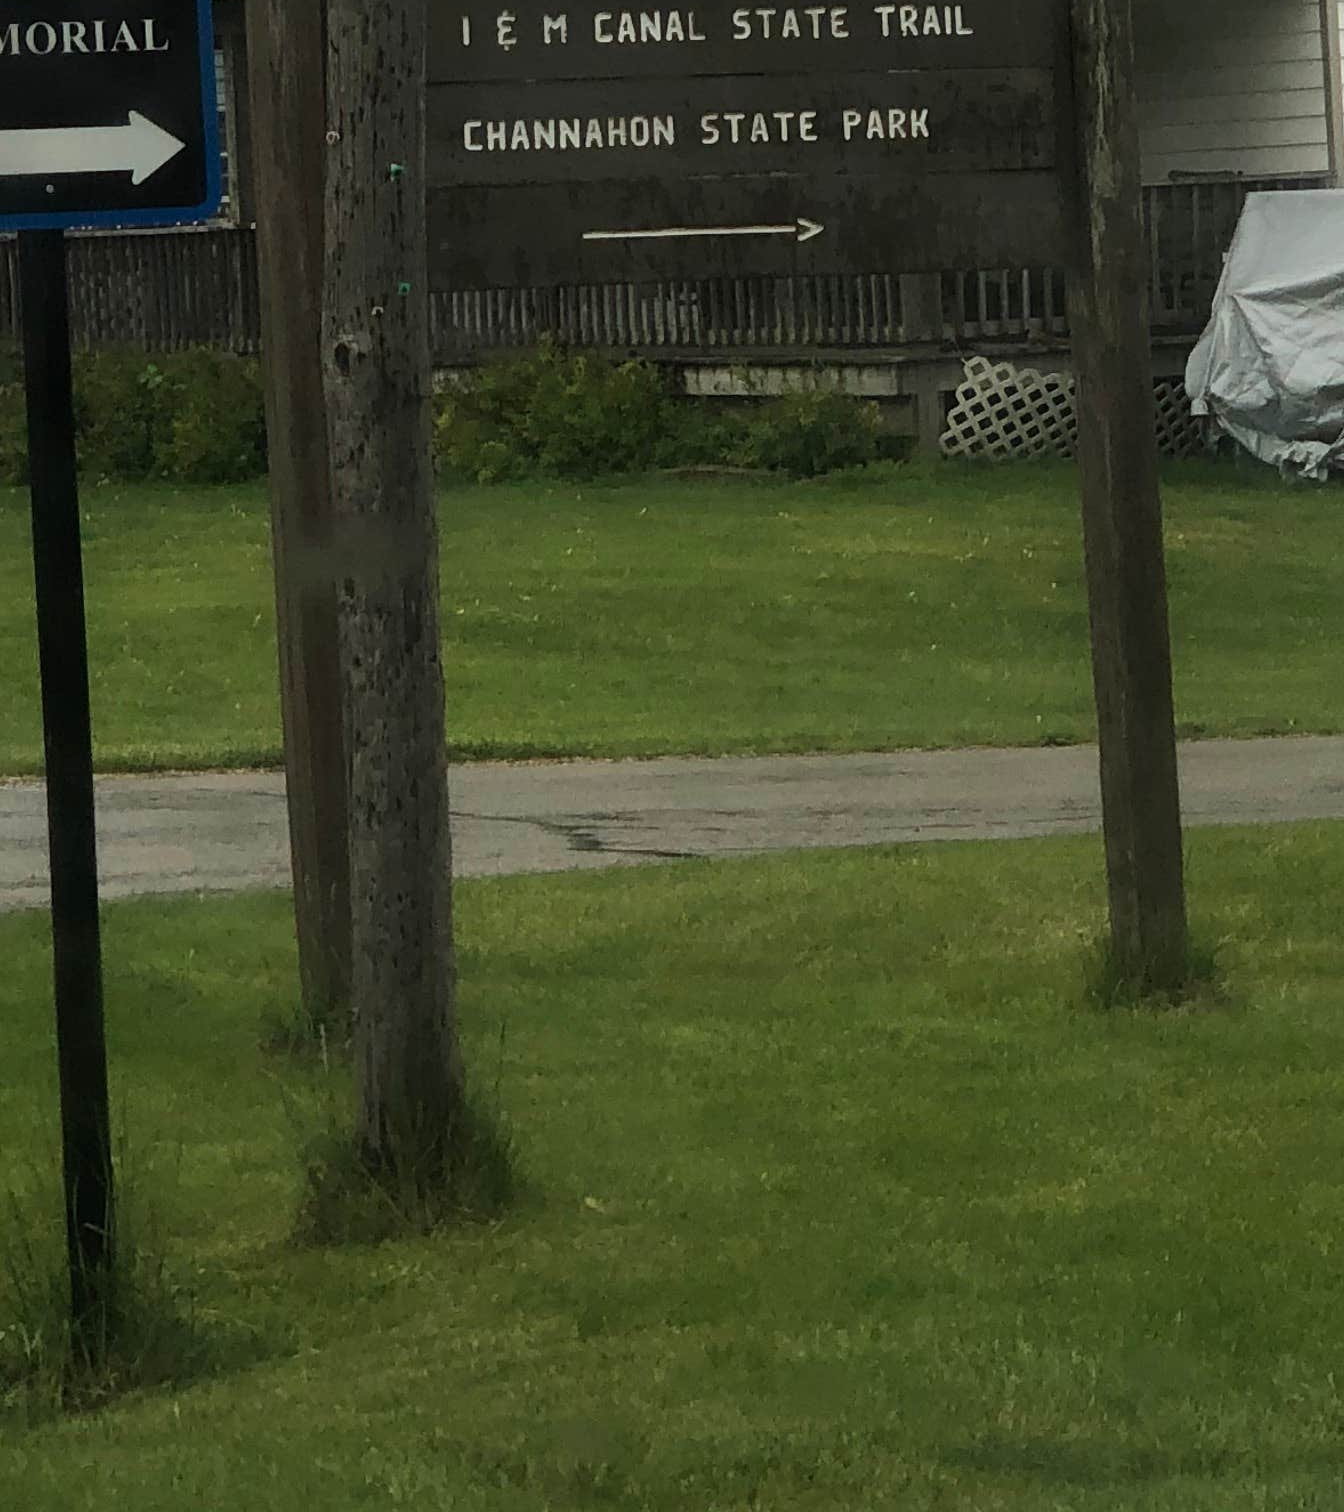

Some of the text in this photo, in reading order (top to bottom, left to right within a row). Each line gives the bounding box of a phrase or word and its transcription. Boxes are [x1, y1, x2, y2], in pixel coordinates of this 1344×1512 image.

[461, 4, 974, 52] I & M CANAL STATE TRAIL
[463, 107, 930, 153] CHANNAHON STATE PARK
